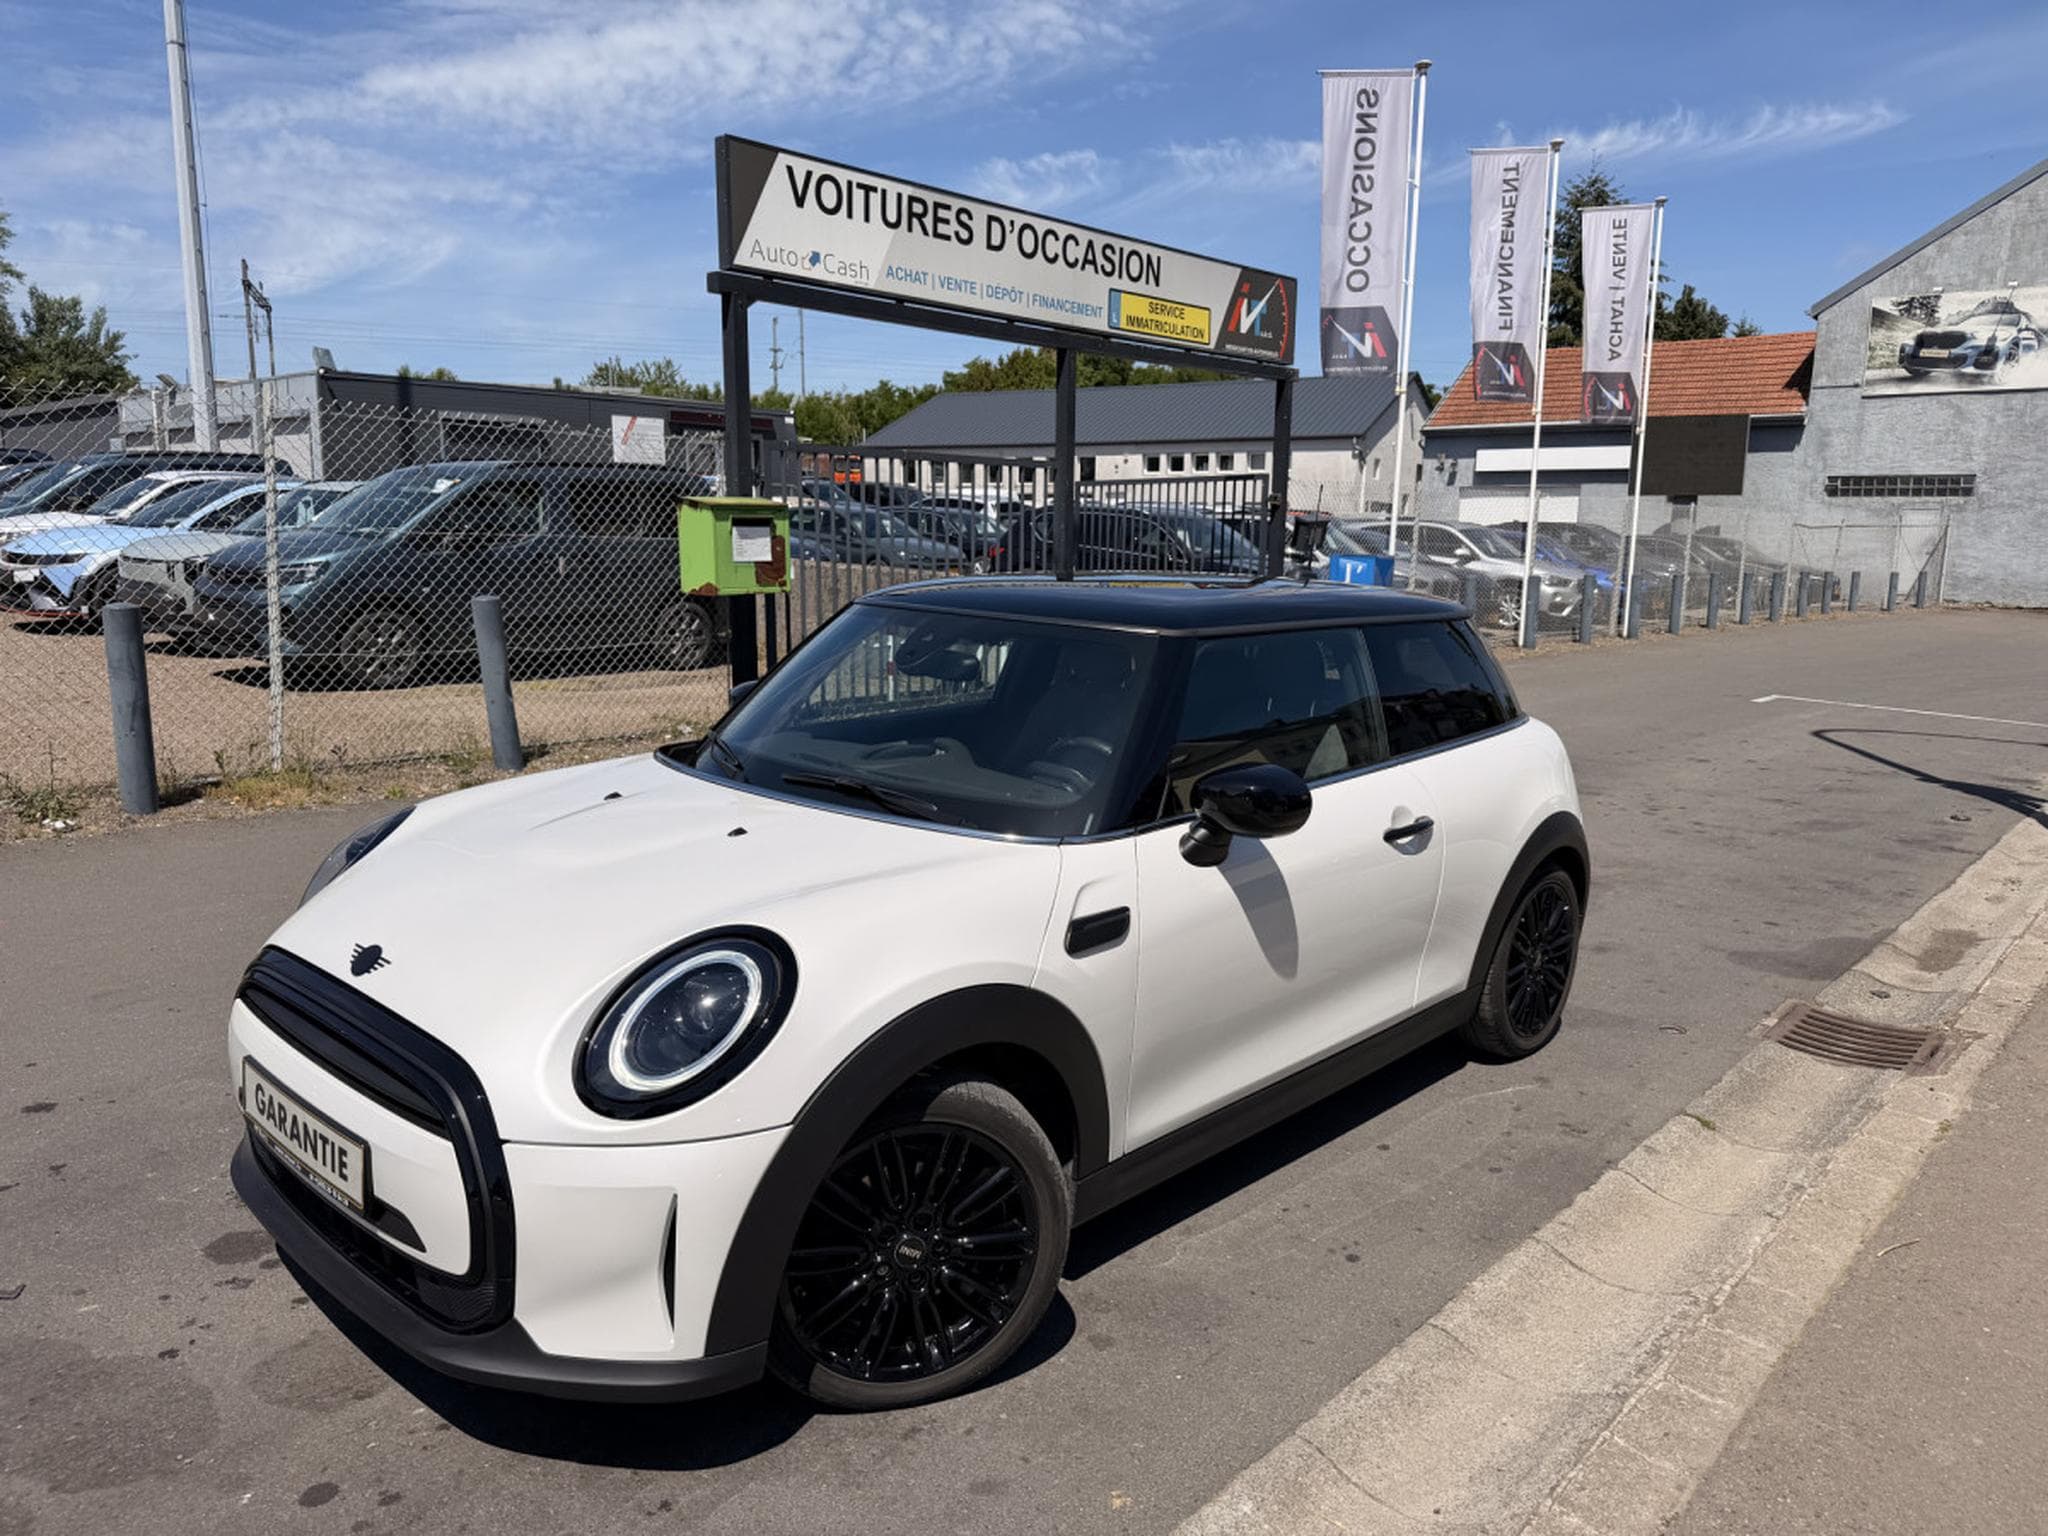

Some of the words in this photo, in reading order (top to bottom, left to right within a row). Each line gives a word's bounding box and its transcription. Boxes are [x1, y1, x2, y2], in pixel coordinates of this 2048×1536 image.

[786, 164, 974, 246] VOITURES
[986, 213, 1162, 287] D'OCCASION
[823, 253, 870, 281] Cash
[885, 265, 929, 286] ACHAT
[938, 276, 977, 295] VENTE
[1032, 293, 1104, 319] FINANCEMENT
[1148, 301, 1186, 320] SERVICE
[1126, 314, 1205, 339] IMMATRICULATION
[255, 1083, 349, 1182] GARANTIE
